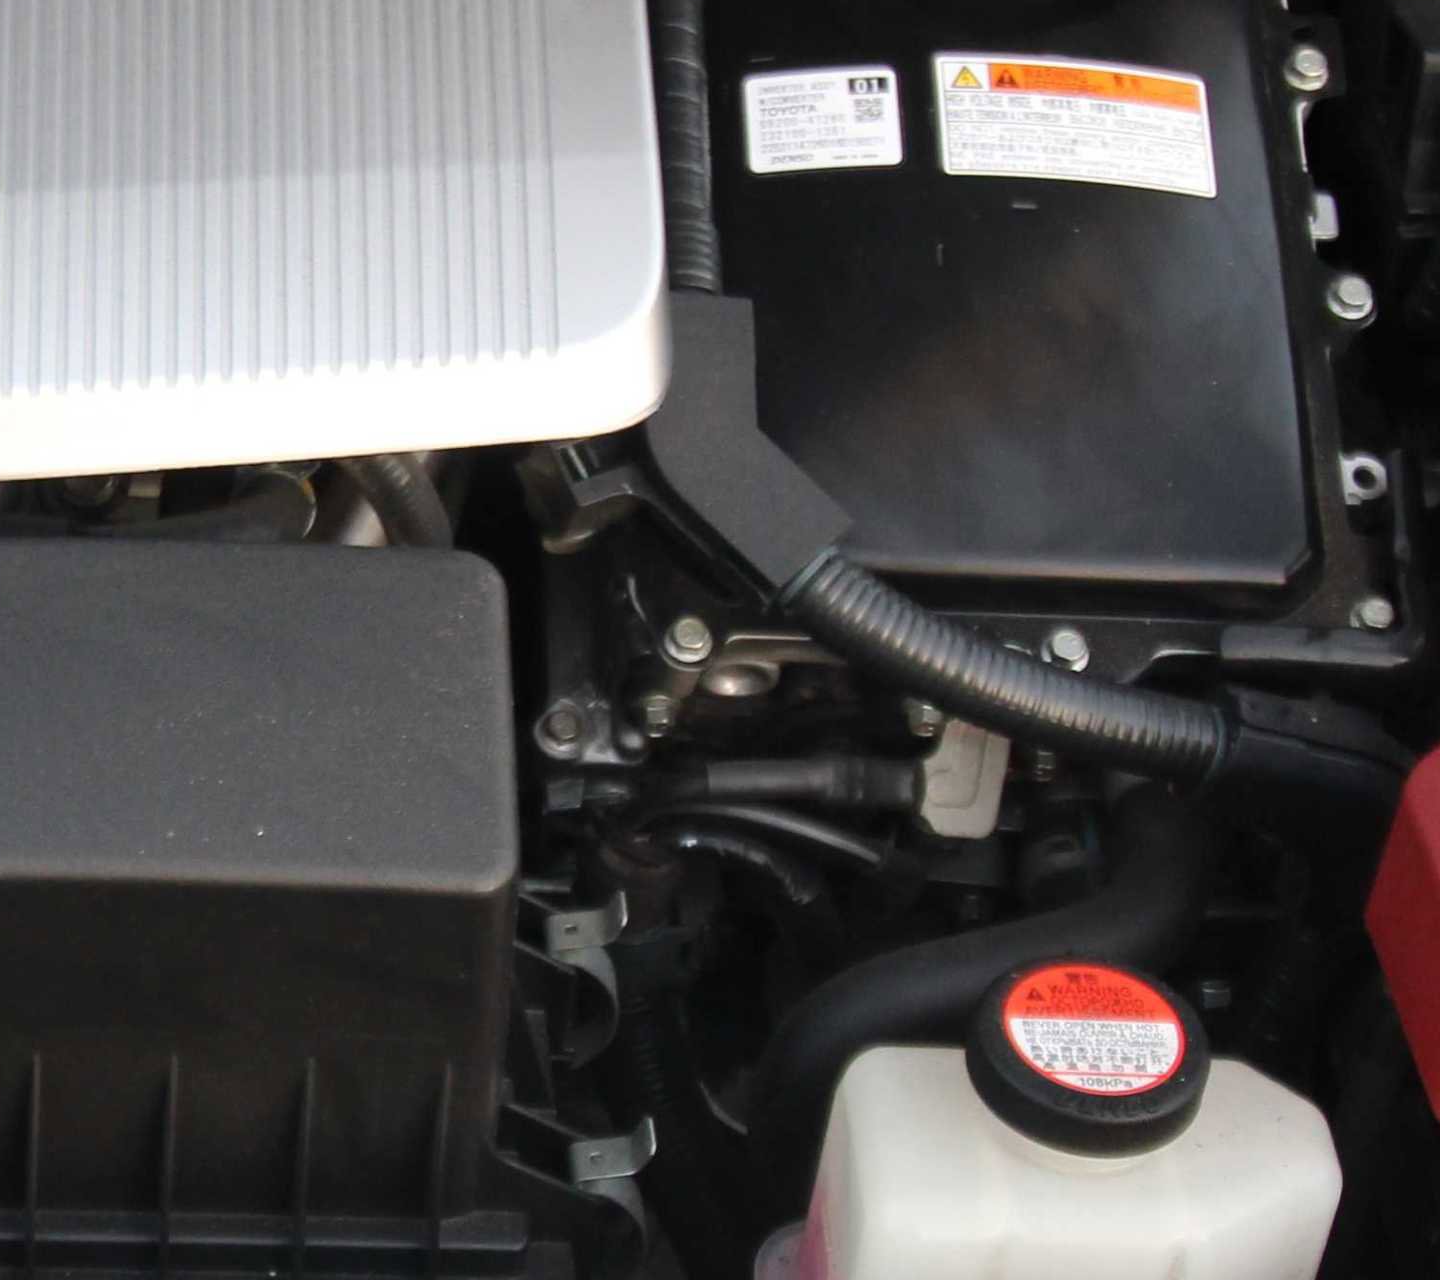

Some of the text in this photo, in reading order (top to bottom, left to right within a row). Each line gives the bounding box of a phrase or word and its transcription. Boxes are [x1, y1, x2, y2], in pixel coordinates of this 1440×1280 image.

[855, 79, 880, 94] 01
[760, 105, 817, 117] TOYOTA
[1049, 984, 1133, 999] WARNING
[1065, 1021, 1097, 1030] OPEN
[1099, 1022, 1133, 1031] WHEN
